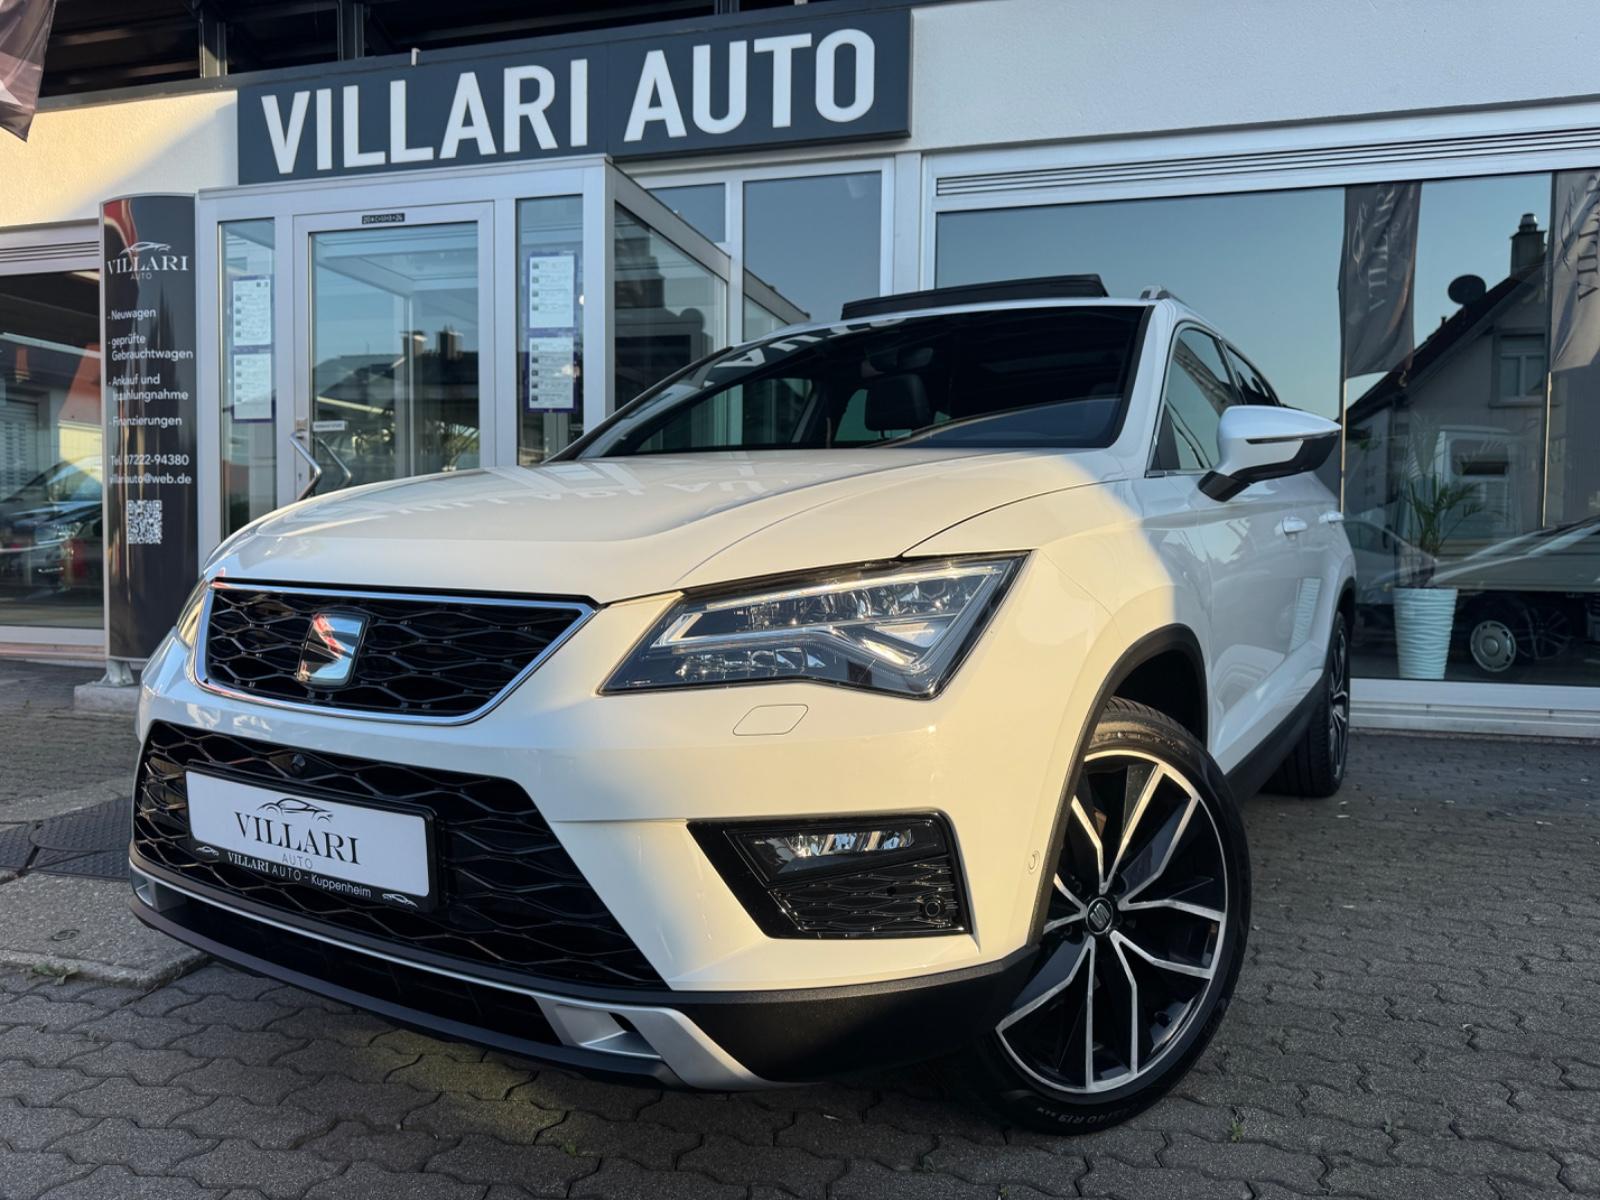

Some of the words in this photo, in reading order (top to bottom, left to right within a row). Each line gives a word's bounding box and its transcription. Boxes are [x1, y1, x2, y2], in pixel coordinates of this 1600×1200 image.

[261, 58, 588, 175] VILLARI
[623, 28, 875, 143] AUTO
[107, 255, 189, 275] VILLARI
[130, 272, 152, 280] AUTO
[112, 347, 194, 362] Gebrauchtwagen
[140, 373, 160, 385] und
[234, 811, 361, 866] VILLARI
[281, 852, 314, 870] AUTO
[227, 851, 271, 873] VILLARI
[271, 867, 302, 882] AUTO
[311, 873, 373, 898] Kuppenheim
